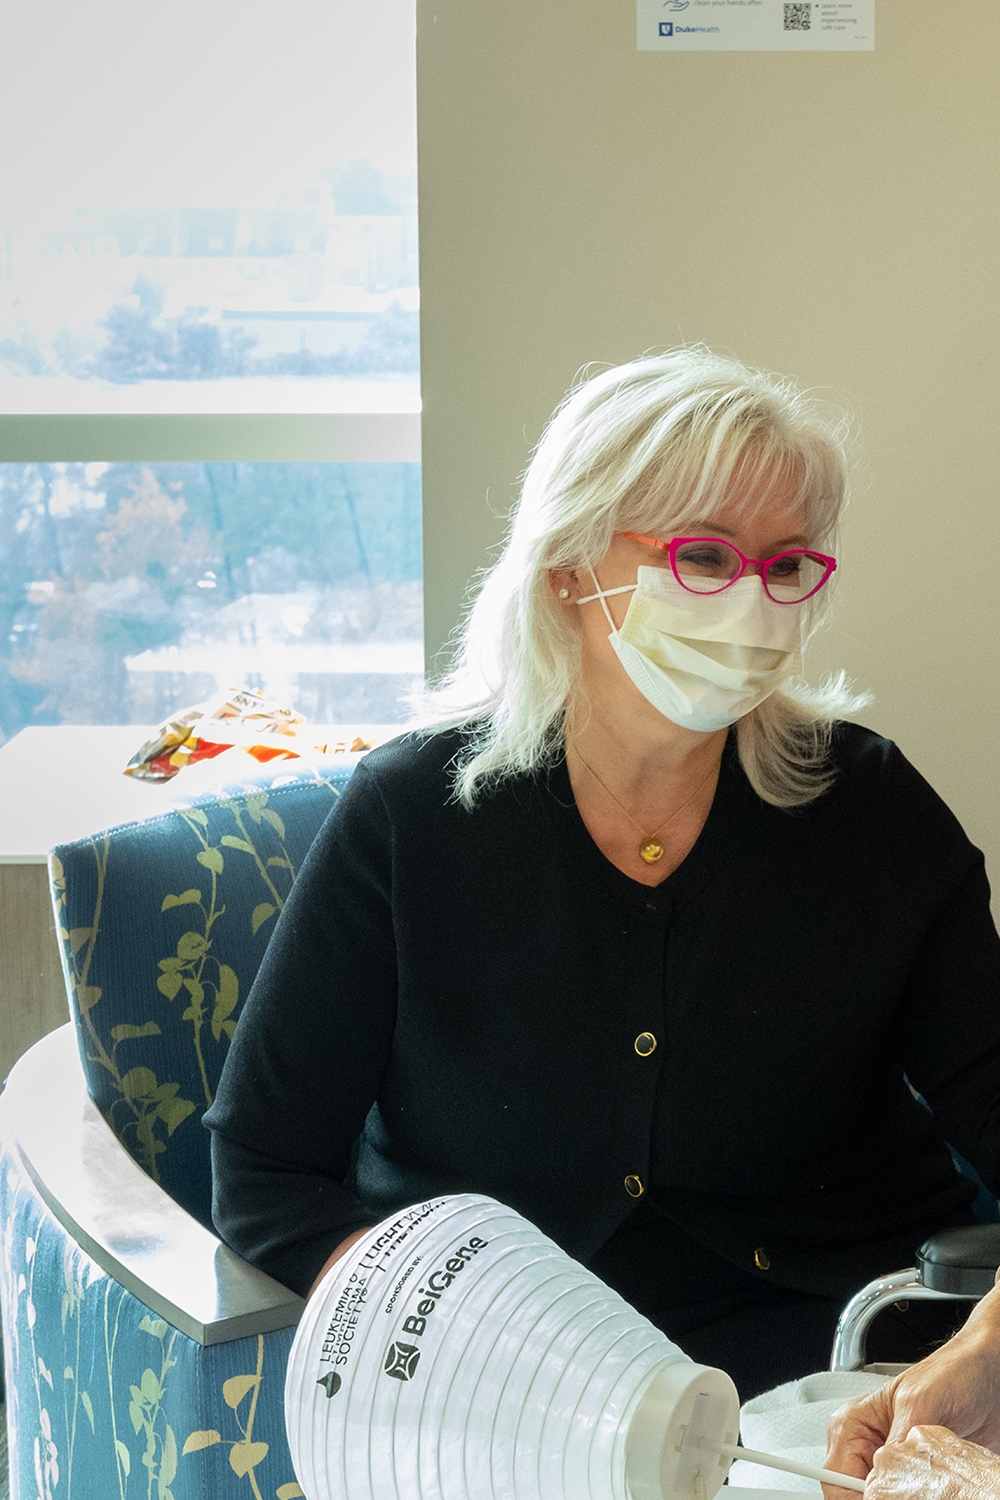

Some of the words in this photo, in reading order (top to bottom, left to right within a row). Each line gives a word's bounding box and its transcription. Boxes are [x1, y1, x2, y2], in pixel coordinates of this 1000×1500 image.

[320, 1286, 353, 1364] LEUKEMIA
[385, 1266, 415, 1315] SPONSORED
[402, 1236, 489, 1337] BeiGene
